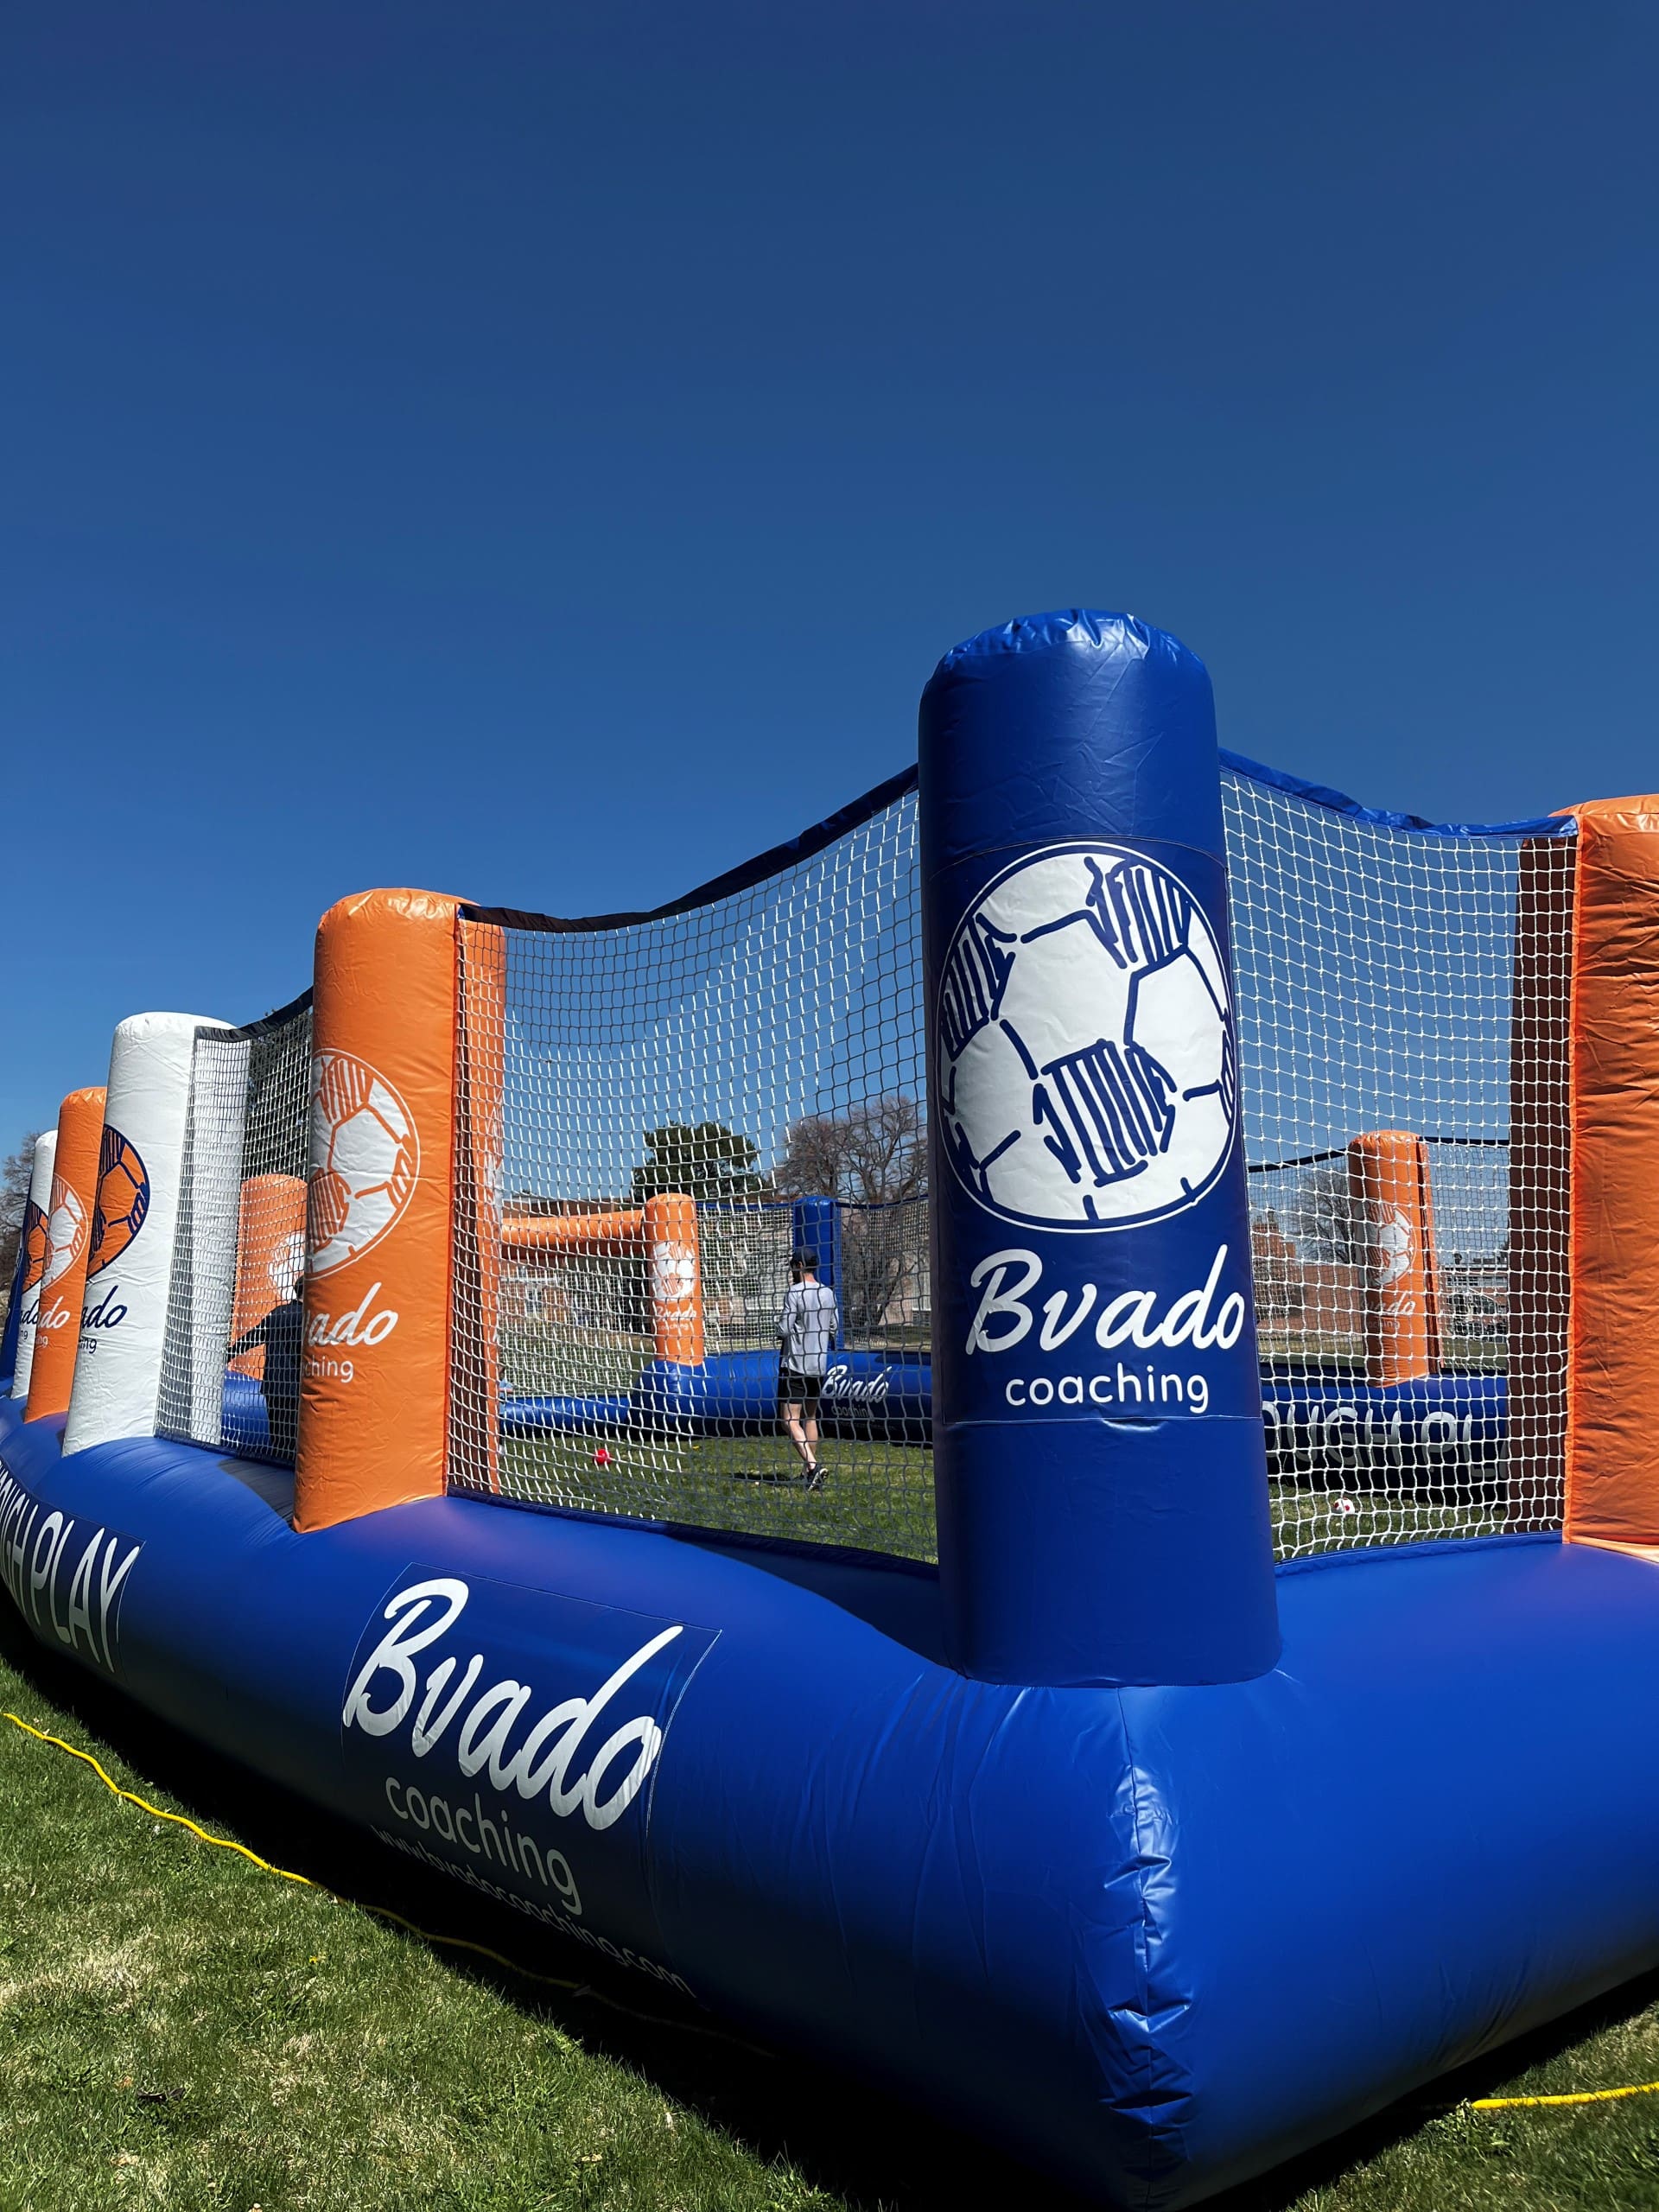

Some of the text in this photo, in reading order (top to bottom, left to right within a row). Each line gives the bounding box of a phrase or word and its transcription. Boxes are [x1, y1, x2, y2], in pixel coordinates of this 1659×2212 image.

[964, 1244, 1245, 1355] Bvado
[821, 1364, 893, 1403] Bvado
[1006, 1363, 1209, 1414] coaching
[30, 1510, 140, 1674] PLAY
[342, 1578, 683, 1831] Bvado
[385, 1777, 582, 1916] coaching
